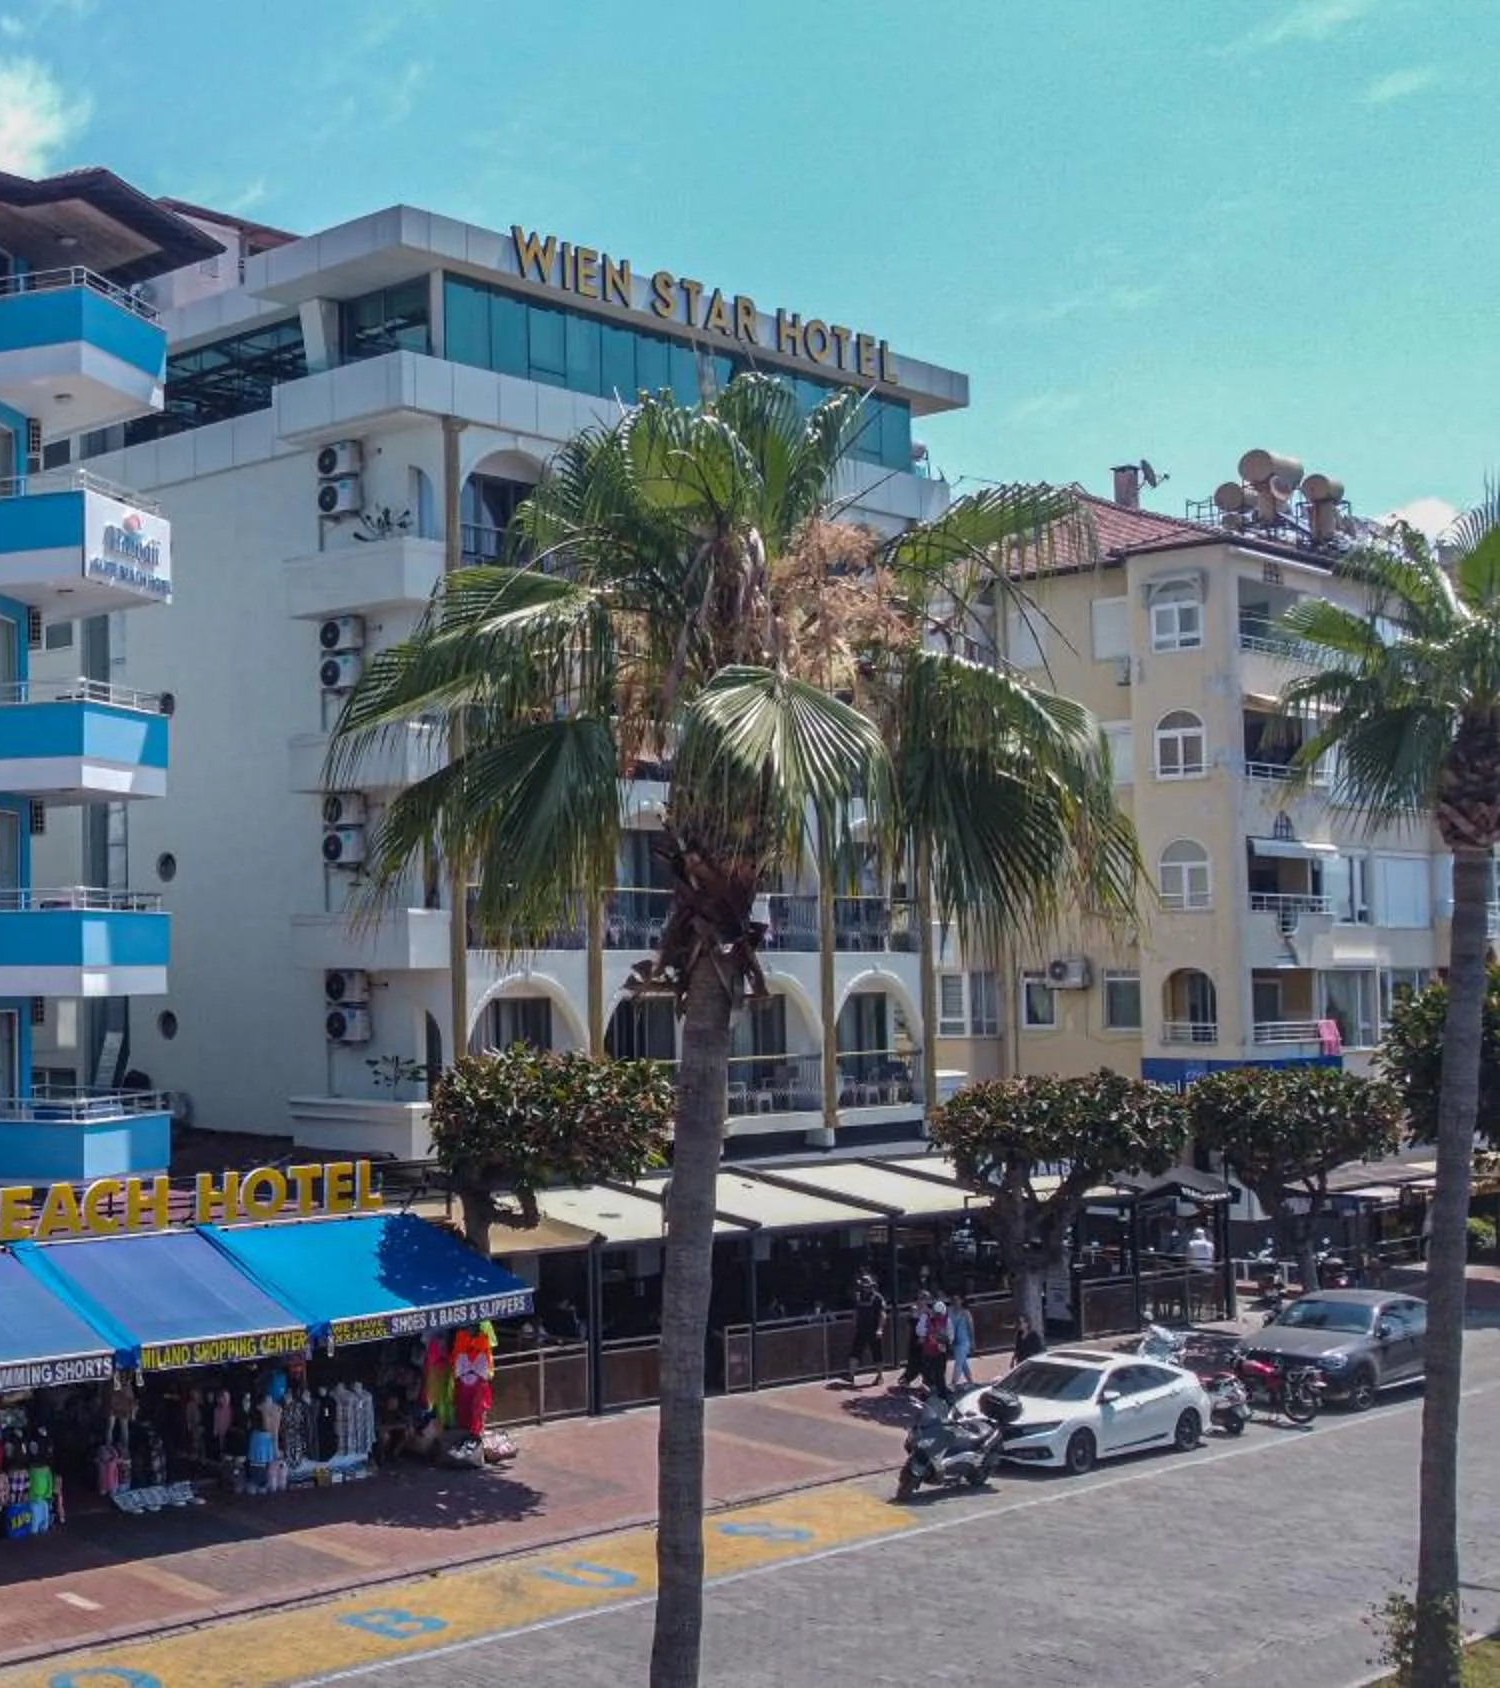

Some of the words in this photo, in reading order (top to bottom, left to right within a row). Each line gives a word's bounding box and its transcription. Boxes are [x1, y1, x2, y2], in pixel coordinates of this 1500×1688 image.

[510, 225, 632, 307] WIEN
[651, 271, 758, 344] STAR
[775, 307, 898, 384] HOTEL
[197, 1159, 383, 1227] HOTEL
[391, 1311, 428, 1334] SHOES
[429, 1308, 437, 1327] &
[439, 1304, 468, 1325] BAGS
[479, 1294, 526, 1319] SLIPPERS
[193, 1336, 257, 1363] SHOPPING
[259, 1331, 308, 1353] CENTER
[54, 1356, 113, 1384] SHORTS
